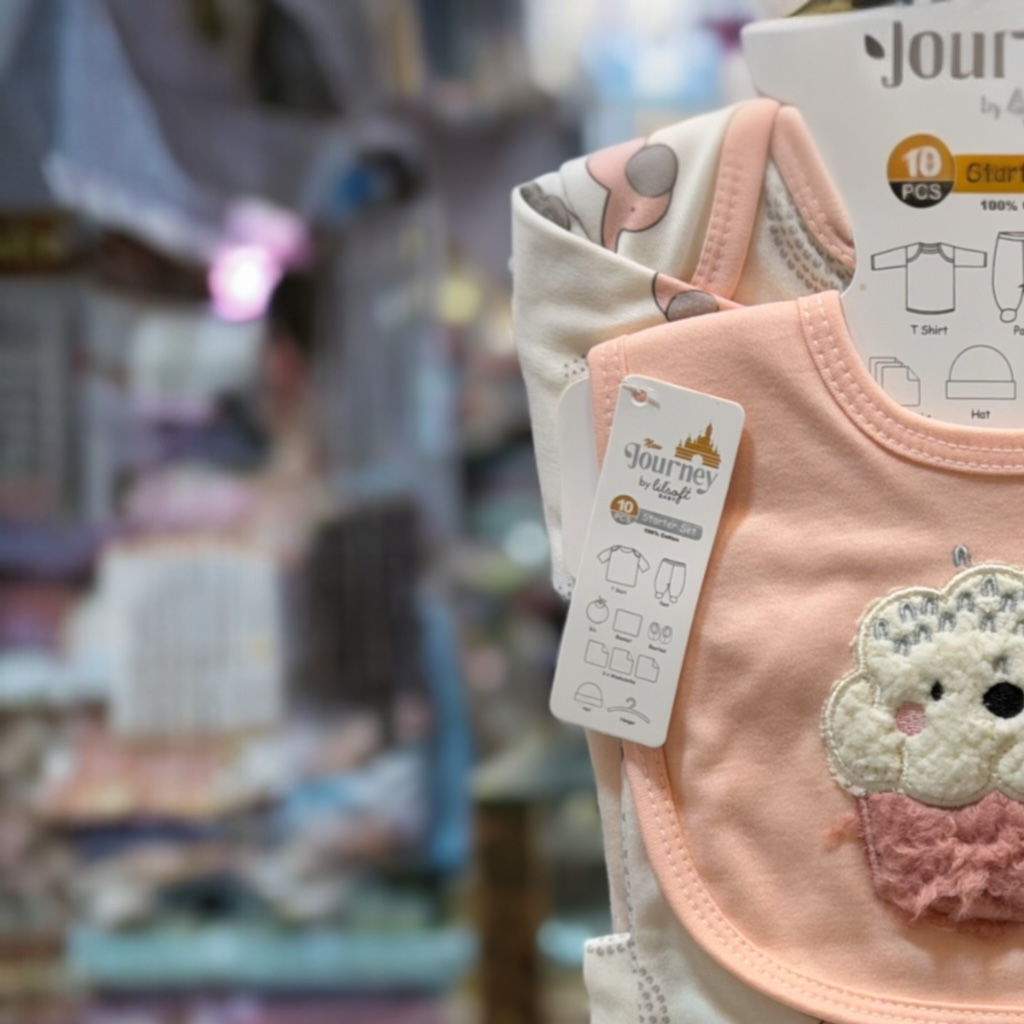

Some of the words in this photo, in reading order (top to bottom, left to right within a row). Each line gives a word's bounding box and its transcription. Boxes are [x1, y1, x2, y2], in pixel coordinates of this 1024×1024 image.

[902, 145, 942, 178] 10
[902, 183, 942, 201] PCS
[980, 200, 1018, 212] 100%
[910, 324, 918, 336] T
[921, 324, 948, 336] Shirt
[971, 409, 991, 420] Hat
[624, 442, 719, 495] Journey
[638, 475, 651, 490] by
[652, 478, 692, 505] lilsoft
[616, 498, 634, 514] 10
[641, 512, 678, 530] Starter
[679, 521, 697, 536] Set
